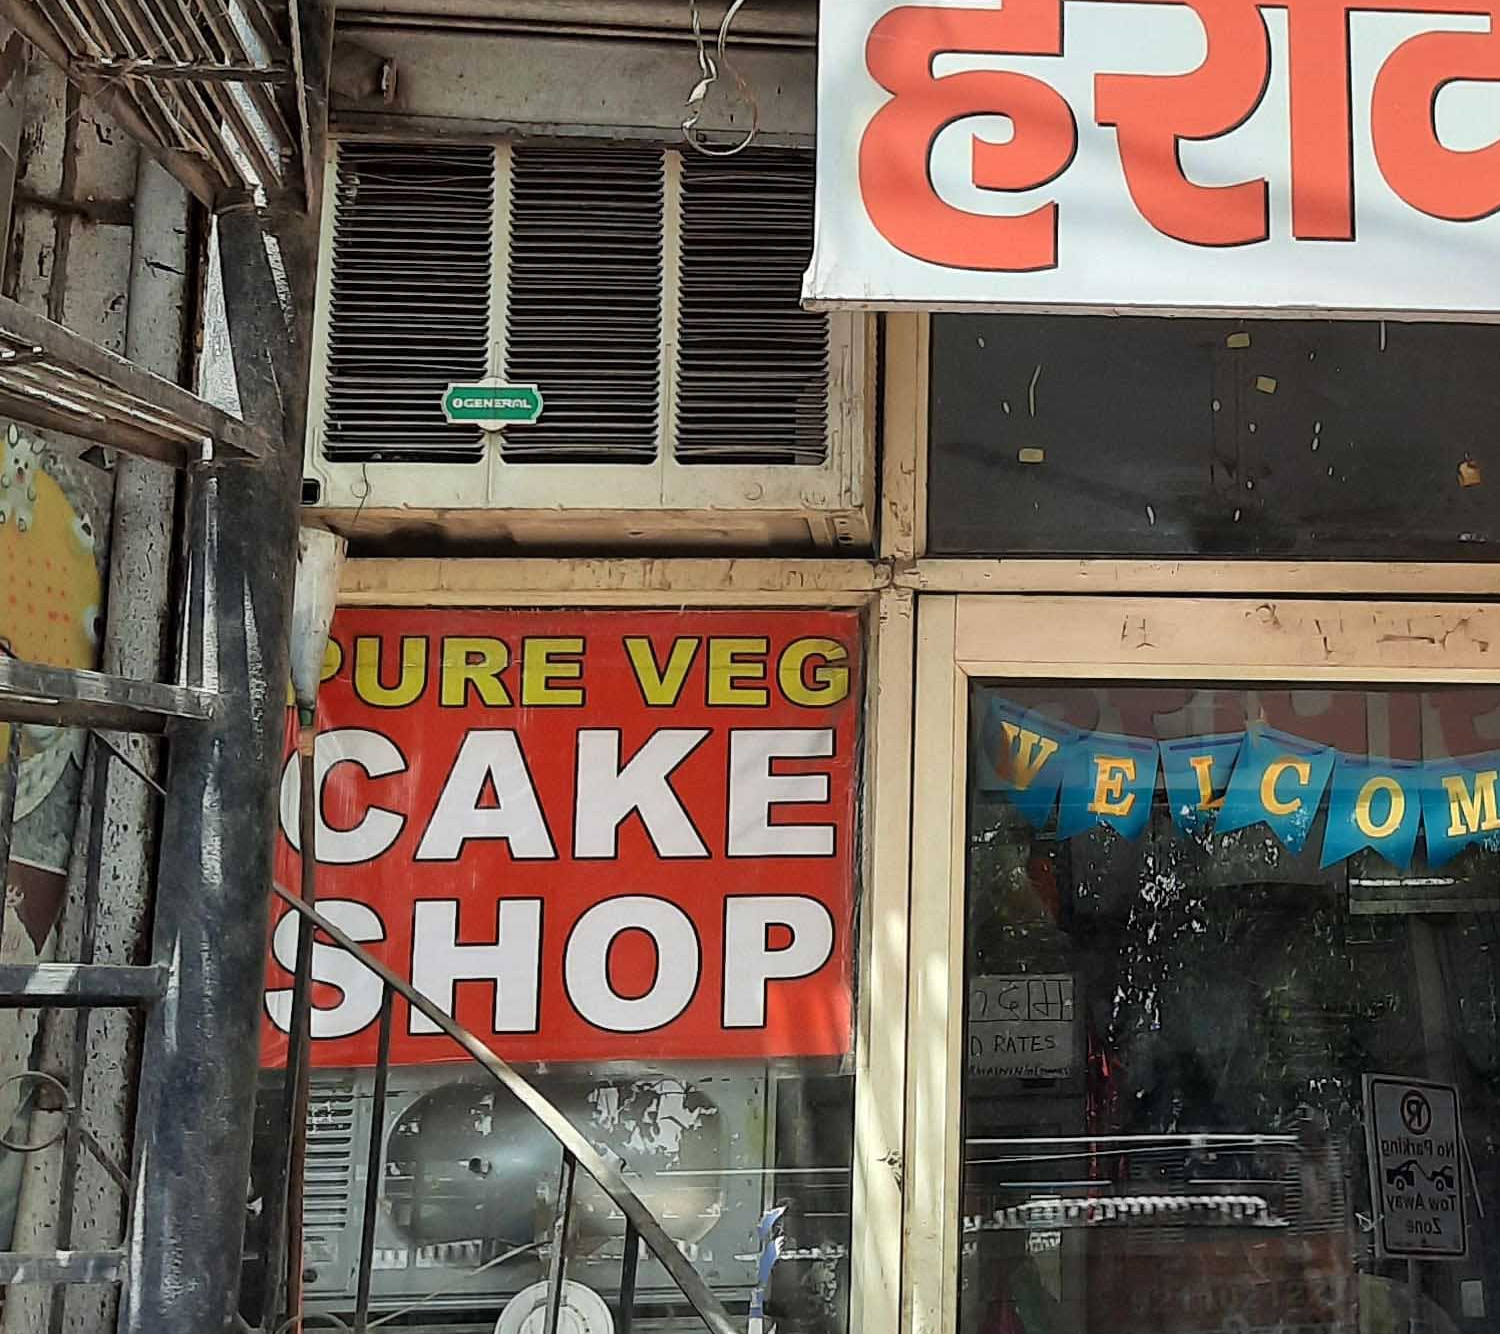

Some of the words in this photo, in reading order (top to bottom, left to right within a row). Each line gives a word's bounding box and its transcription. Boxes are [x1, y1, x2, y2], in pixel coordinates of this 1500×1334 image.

[624, 636, 850, 708] VEG
[278, 727, 838, 865] CAKE
[263, 894, 837, 1041] SHOP
[994, 1034, 1057, 1054] RATES
